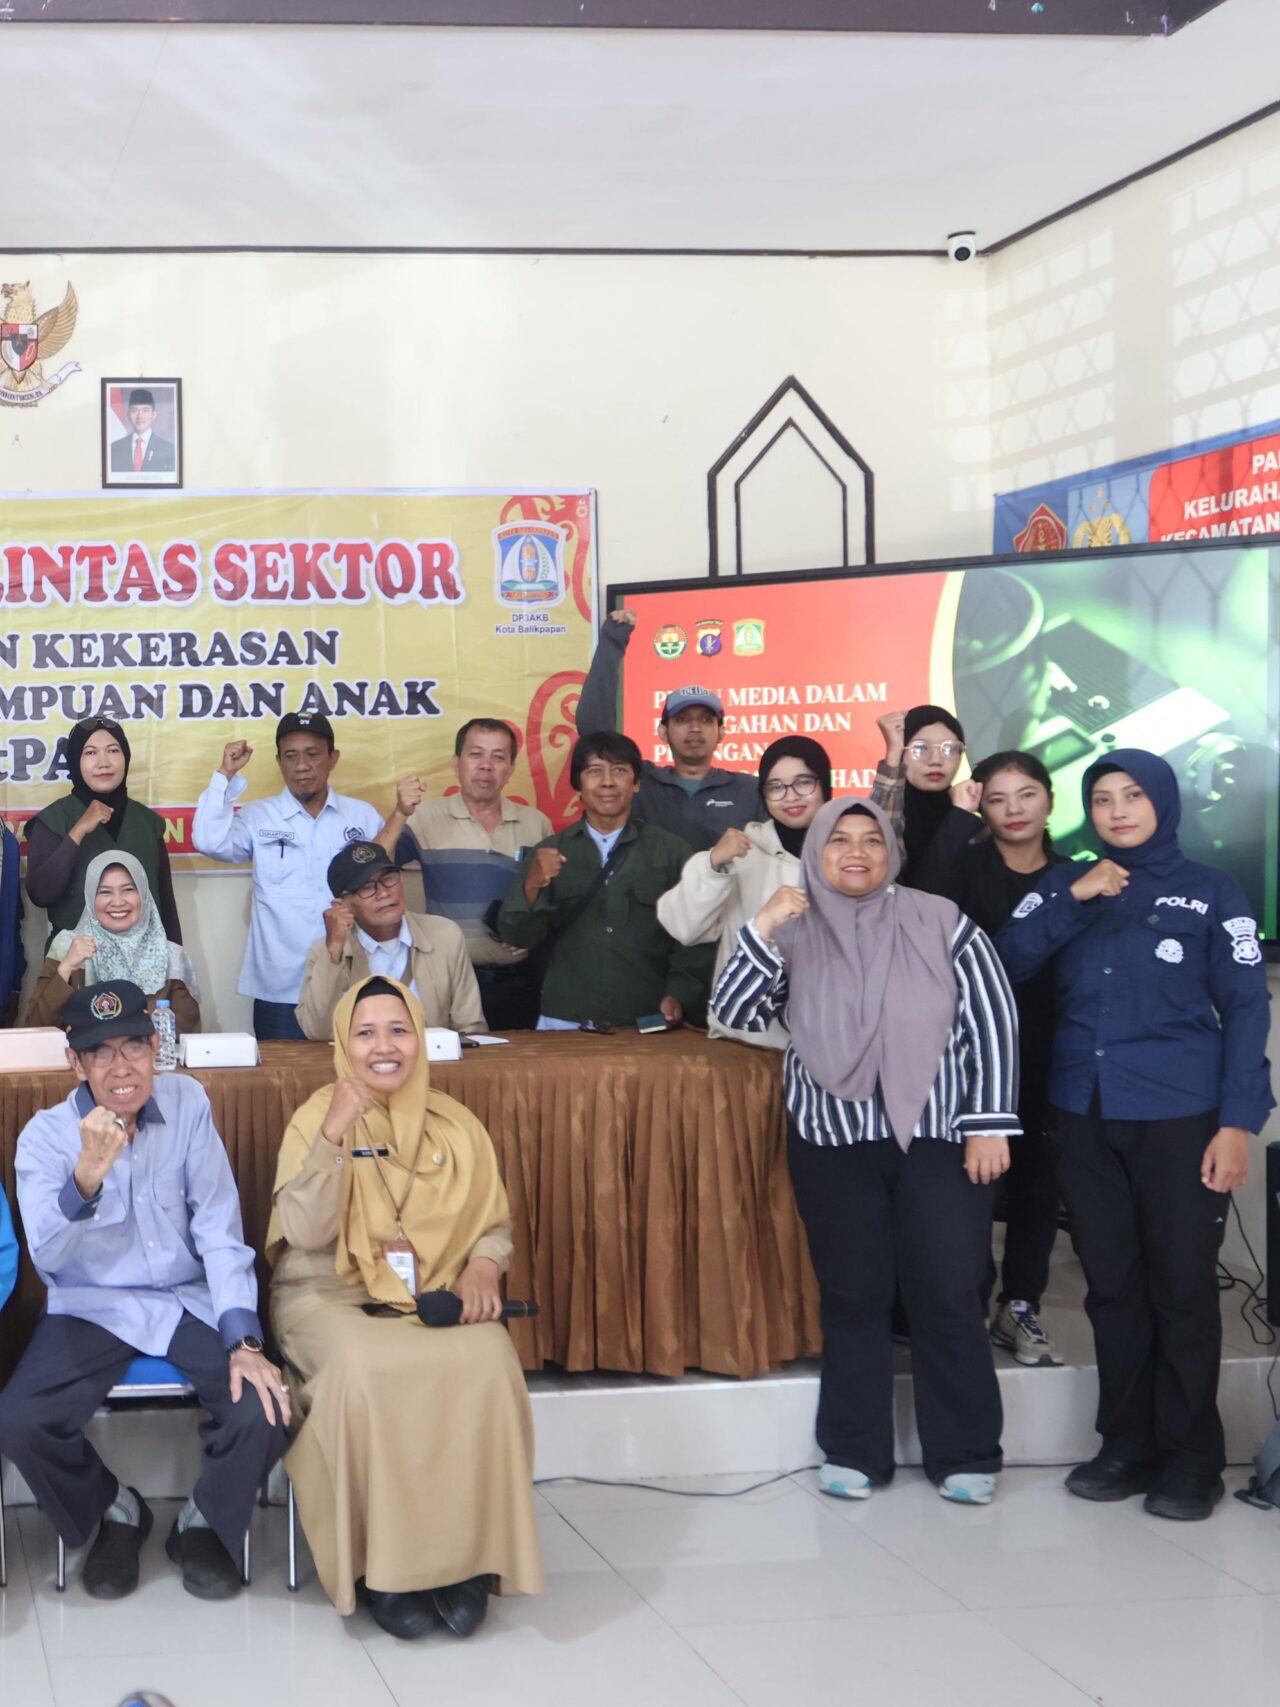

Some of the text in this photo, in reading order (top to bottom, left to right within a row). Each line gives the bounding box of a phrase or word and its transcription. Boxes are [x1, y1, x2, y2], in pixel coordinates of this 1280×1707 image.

[1184, 481, 1280, 520] KELURAH
[213, 542, 461, 601] SEKTOR
[496, 625, 566, 634] Kota Balikpapan
[512, 614, 549, 622] DP3AKB
[32, 631, 339, 668] KEKERASAN
[179, 682, 285, 718] DAN
[297, 680, 440, 717] ANAK
[727, 685, 800, 707] MEDIA
[805, 682, 888, 705] DALAM
[803, 712, 851, 733] DAN
[1155, 896, 1209, 915] POLRI
